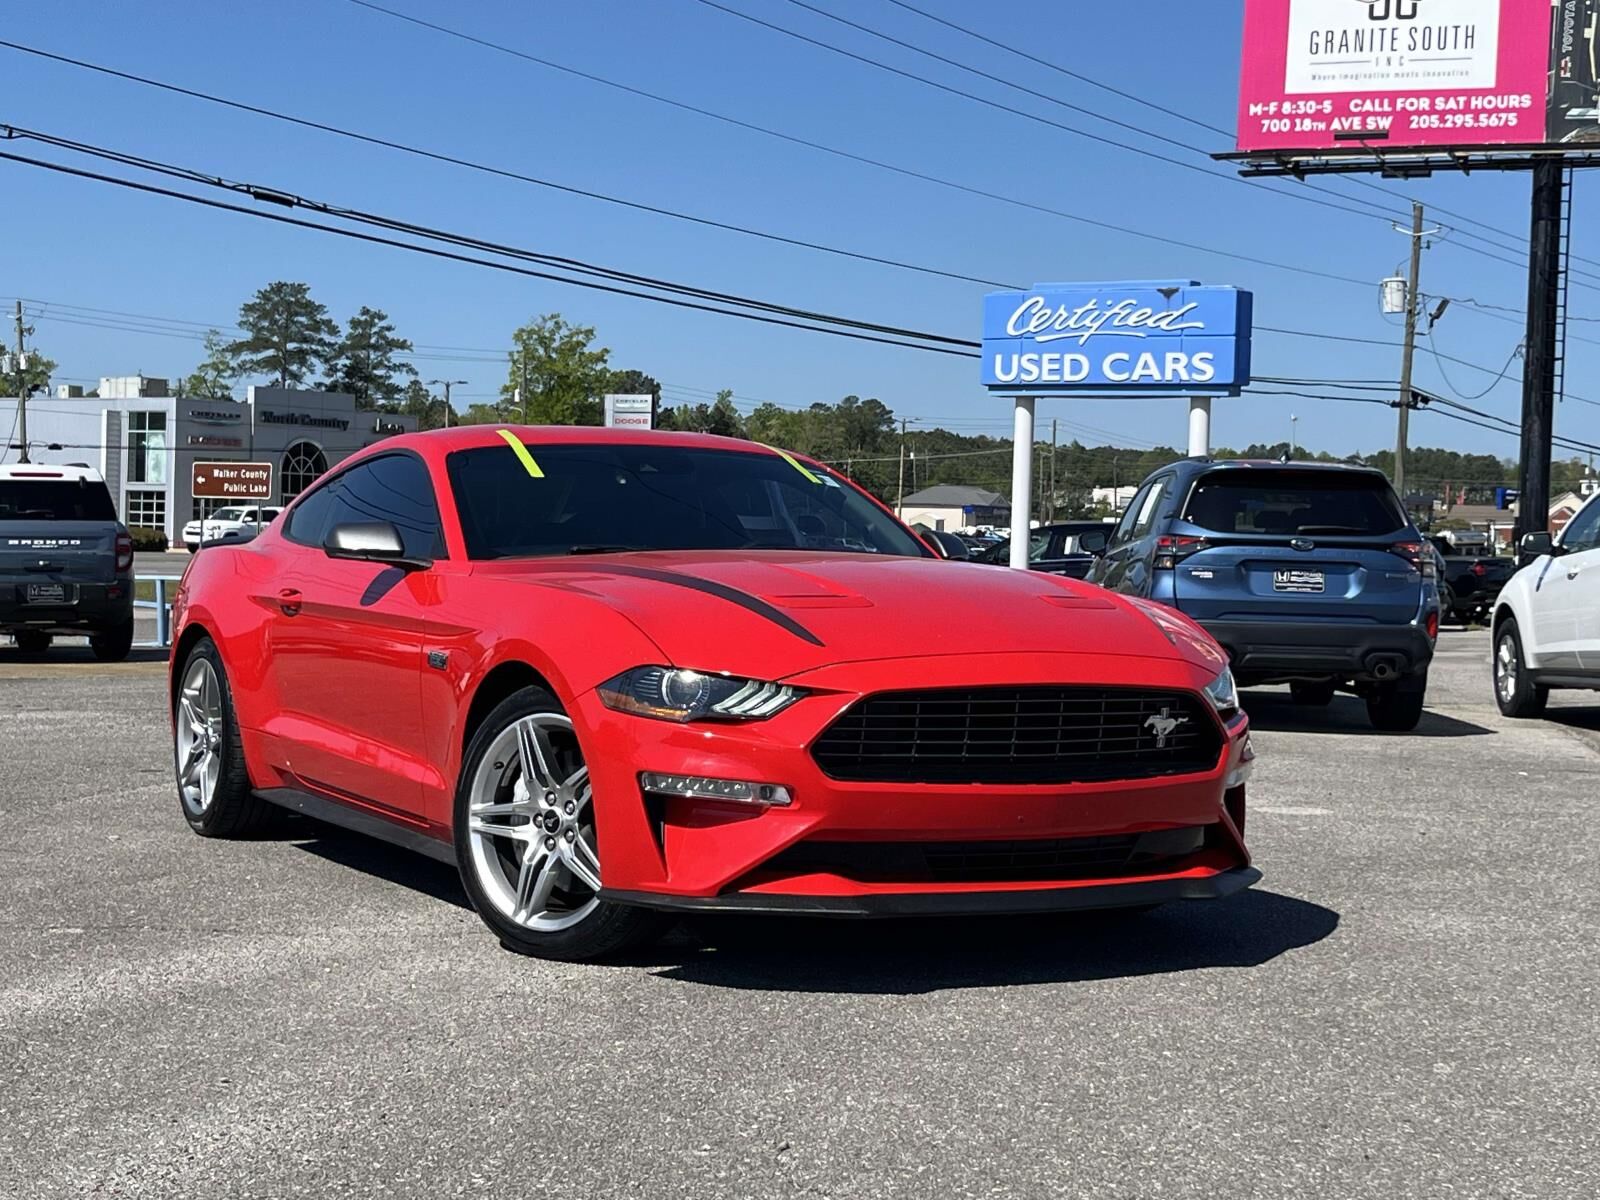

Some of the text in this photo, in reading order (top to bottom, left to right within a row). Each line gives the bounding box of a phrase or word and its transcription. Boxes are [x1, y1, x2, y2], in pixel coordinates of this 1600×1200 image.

[1562, 0, 1577, 53] TOYOTA
[1309, 24, 1475, 55] GRANITE SOUTH
[1375, 56, 1404, 67] INC
[1249, 94, 1532, 116] M-F 8:30-5 CALL FOR SAT HOURS
[1261, 119, 1288, 133] 700
[1330, 117, 1361, 131] AVE
[1366, 115, 1393, 130] SW
[1409, 113, 1517, 129] 205.295.5675
[1007, 296, 1204, 346] Certified
[995, 352, 1215, 382] USED CARS
[299, 414, 350, 431] Country
[213, 468, 268, 480] Walker County
[223, 482, 267, 493] Public Lake
